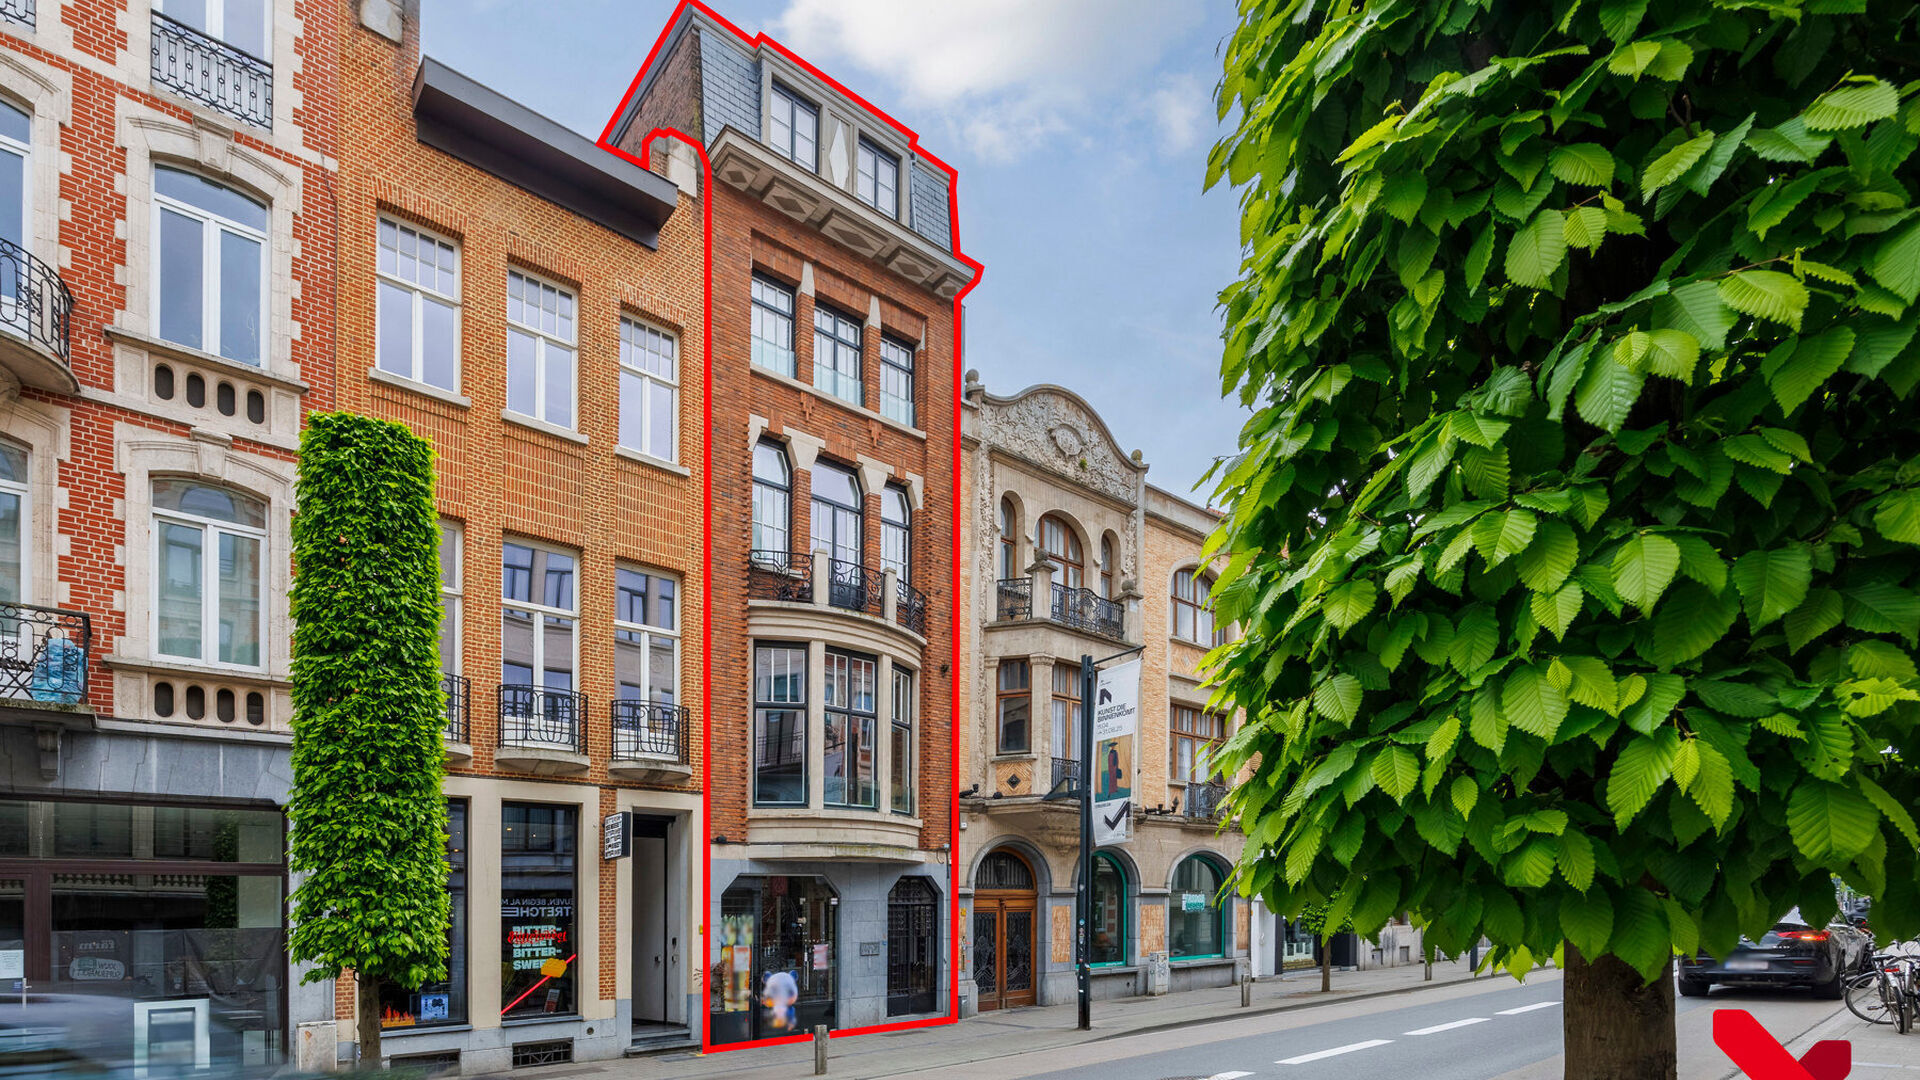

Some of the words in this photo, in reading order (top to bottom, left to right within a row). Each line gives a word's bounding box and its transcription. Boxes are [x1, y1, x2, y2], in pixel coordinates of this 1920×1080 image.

[1098, 706, 1116, 715] KUNST
[513, 947, 562, 958] BITTER-
[513, 959, 548, 970] SWEE
